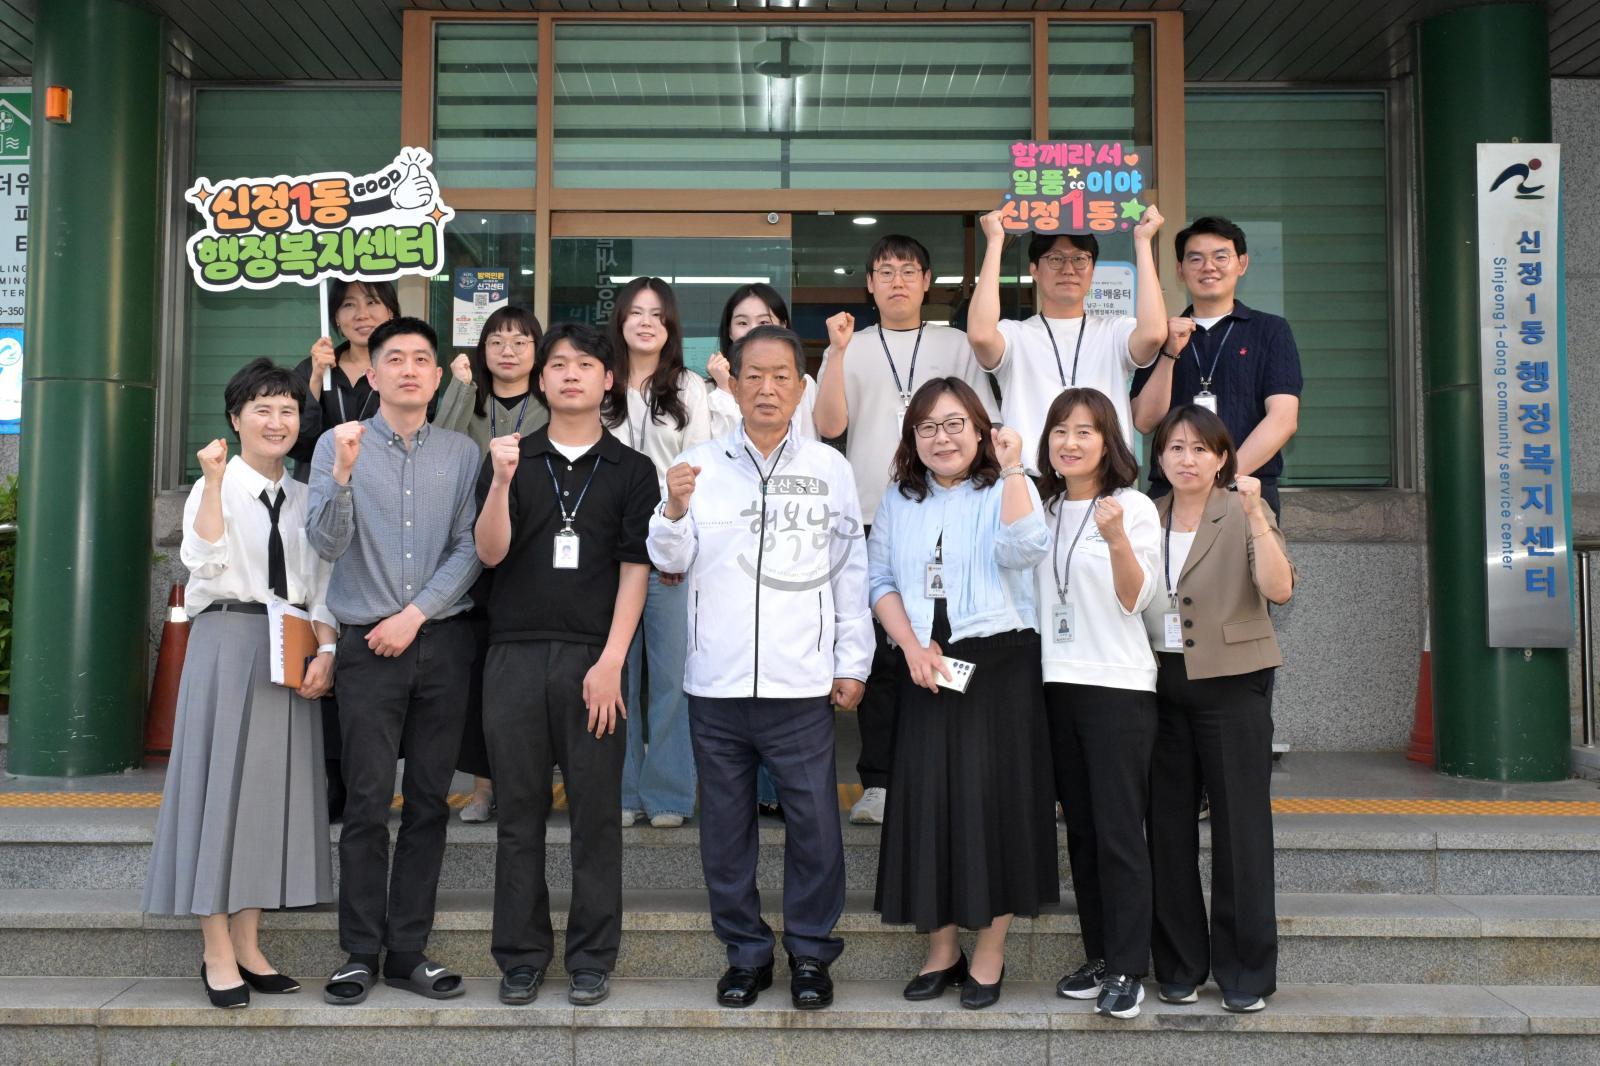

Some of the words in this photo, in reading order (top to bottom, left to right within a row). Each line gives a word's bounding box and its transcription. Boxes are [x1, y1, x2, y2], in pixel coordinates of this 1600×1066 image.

[1011, 142, 1122, 168] 함께라서
[210, 177, 352, 231] 신정1동
[353, 169, 402, 197] GOOD
[1002, 189, 1118, 231] 신정1동
[196, 222, 436, 282] 행정복지센터
[1492, 257, 1507, 321] Sinjeong
[1493, 324, 1509, 377] 1-dong
[1496, 382, 1513, 459] community
[1499, 463, 1514, 518] service
[1501, 523, 1514, 570] center
